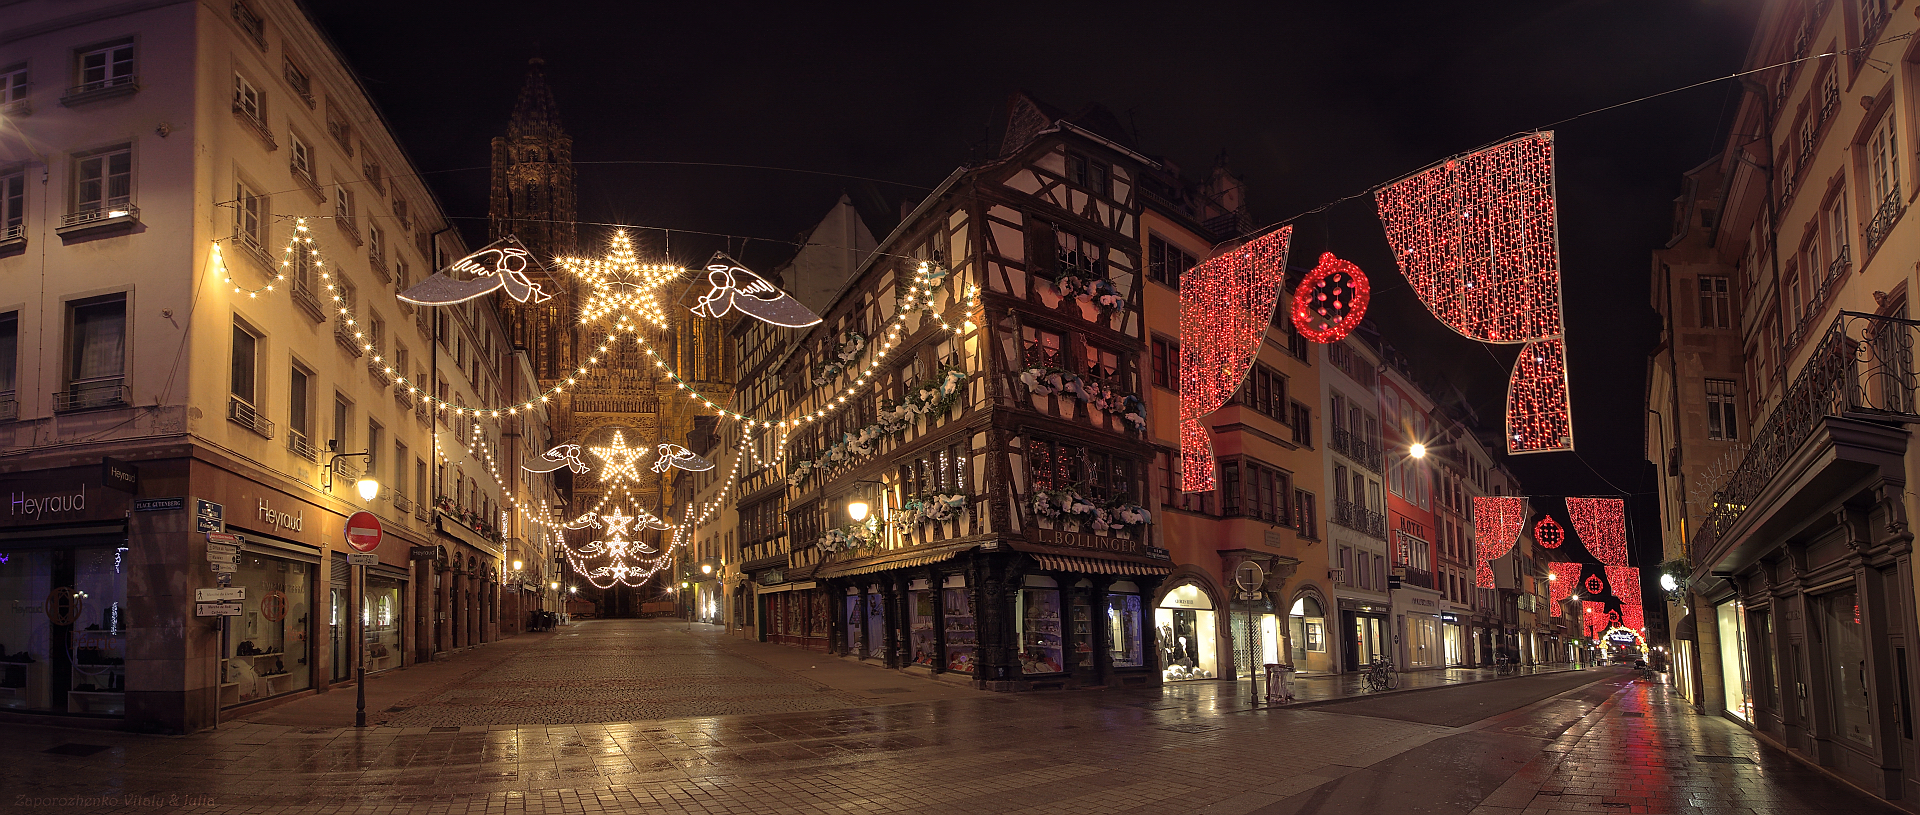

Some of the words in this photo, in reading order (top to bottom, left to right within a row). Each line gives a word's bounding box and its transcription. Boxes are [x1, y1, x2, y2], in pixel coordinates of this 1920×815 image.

[111, 466, 136, 483] Heyraud
[11, 483, 85, 521] Heyraud
[258, 497, 303, 532] Heyraud
[1400, 516, 1425, 539] HOTEL
[412, 549, 435, 557] Heyraud
[69, 630, 117, 651] Féerie
